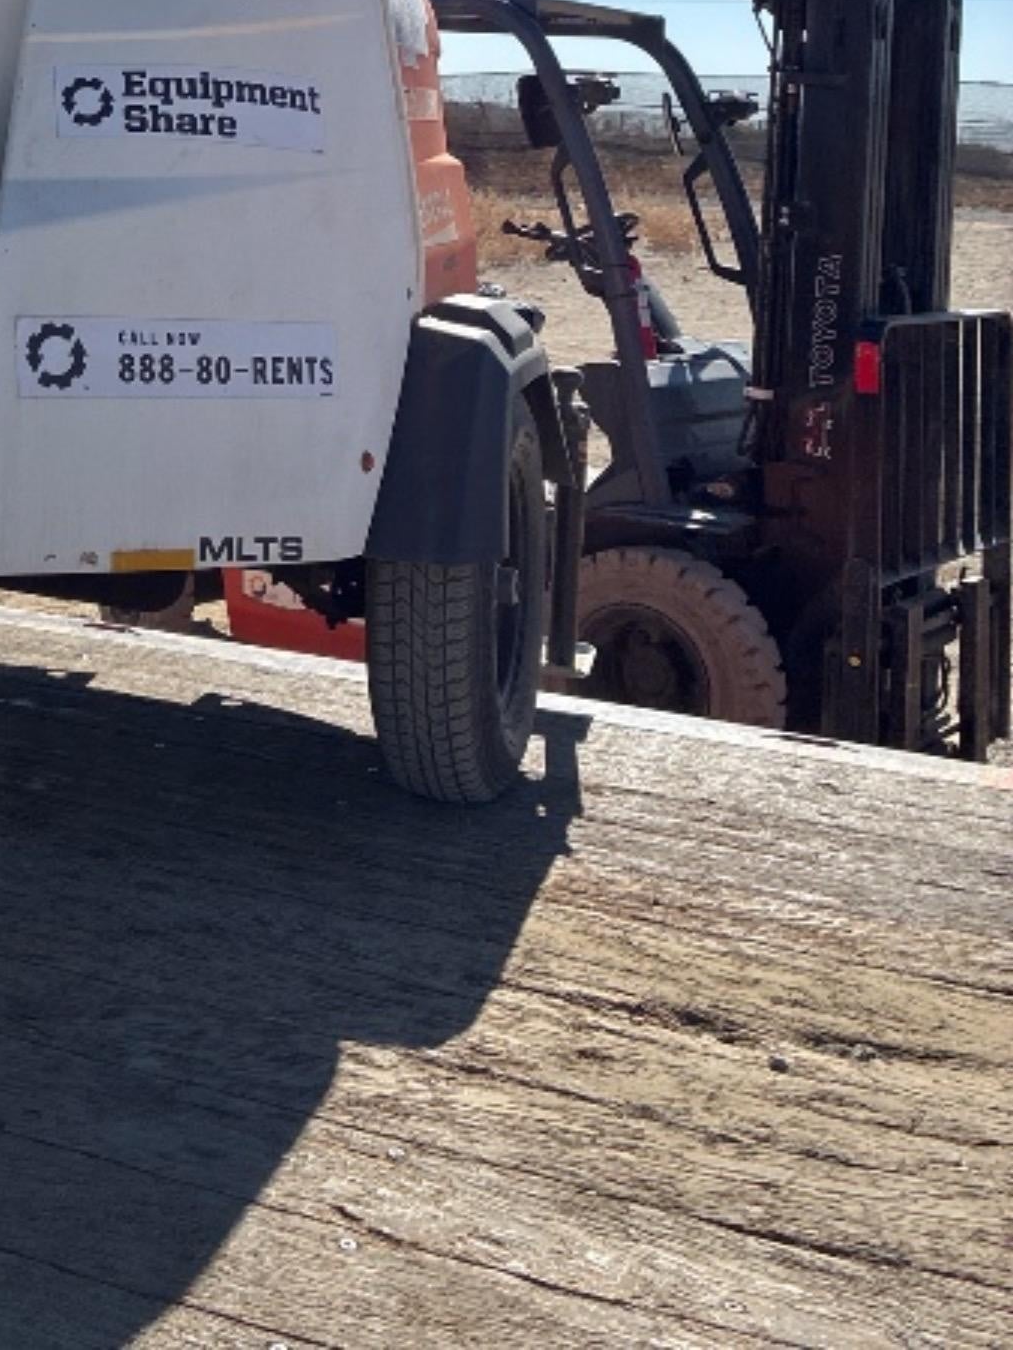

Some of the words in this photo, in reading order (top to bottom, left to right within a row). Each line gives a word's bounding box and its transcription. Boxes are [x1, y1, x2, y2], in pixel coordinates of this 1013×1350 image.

[121, 70, 321, 115] Equipment
[123, 104, 238, 138] Share
[117, 329, 160, 347] CALL
[808, 253, 844, 389] TOYOTA
[117, 352, 334, 386] 888-80-RENTS
[199, 536, 304, 562] MLTS
